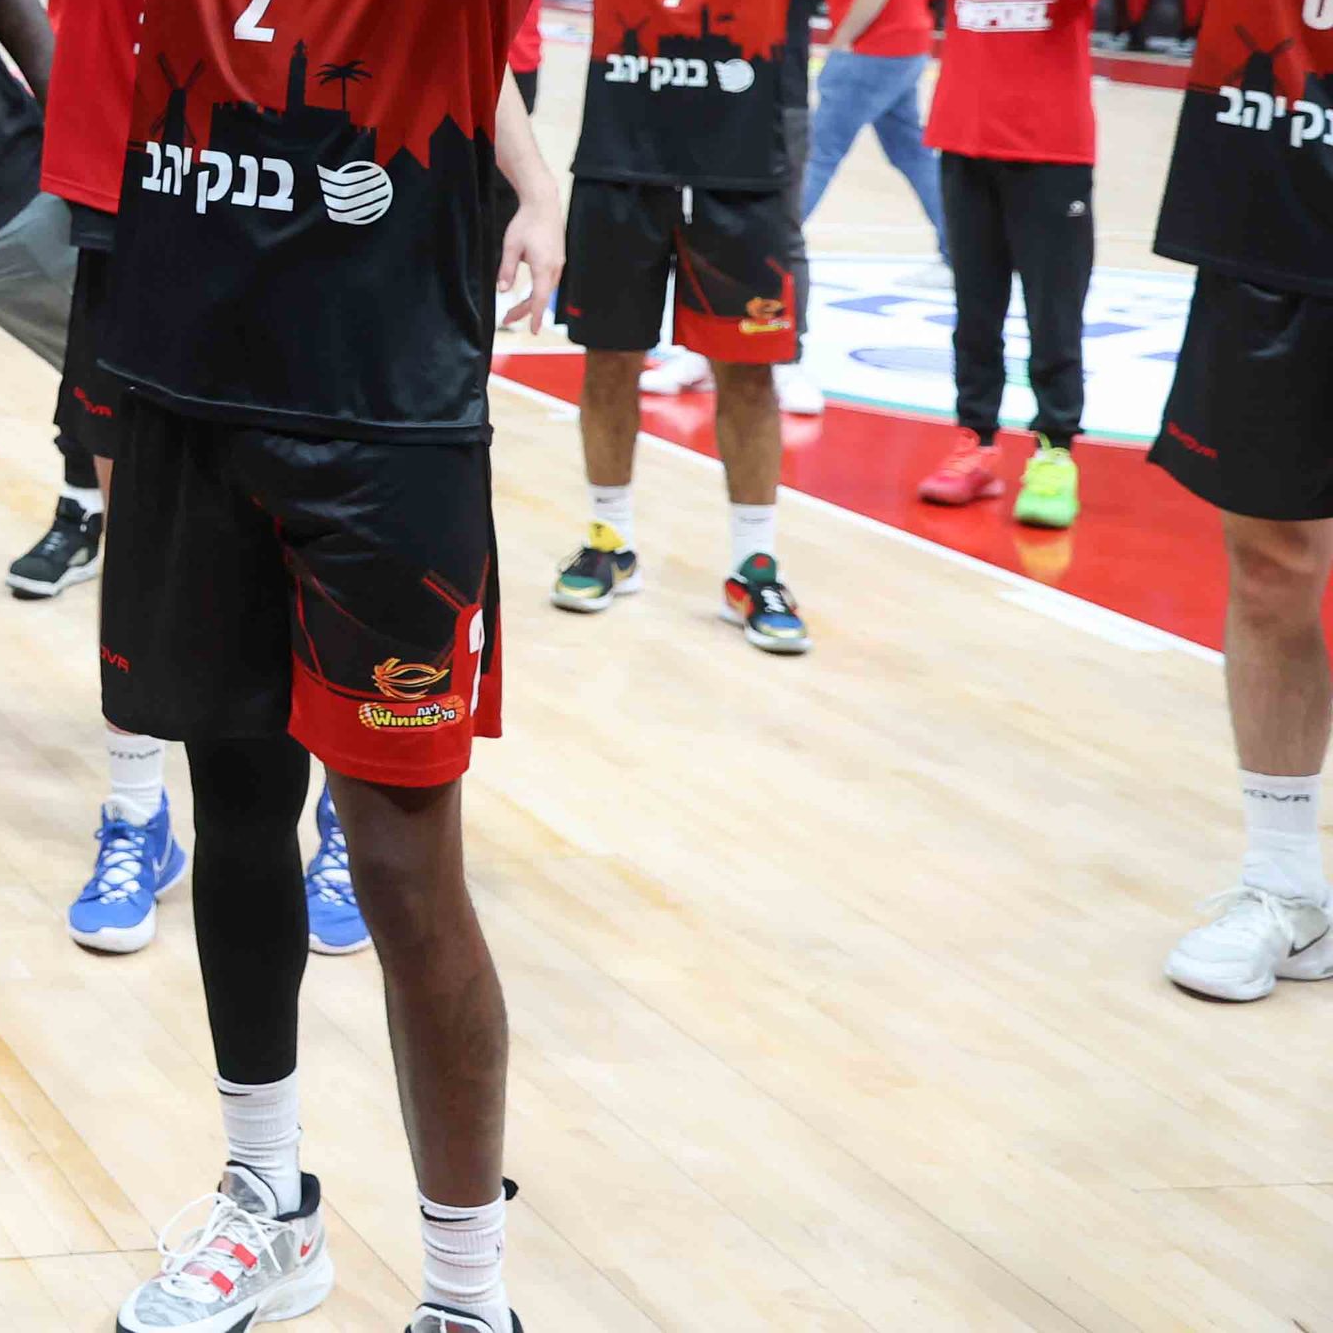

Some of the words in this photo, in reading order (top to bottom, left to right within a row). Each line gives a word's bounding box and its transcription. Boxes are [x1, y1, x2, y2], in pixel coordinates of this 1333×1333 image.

[650, 57, 709, 92] בנק
[1215, 85, 1287, 131] יהב
[141, 140, 193, 197] יהב
[195, 148, 295, 214] בנק
[373, 707, 442, 727] Winner
[441, 708, 455, 721] סל
[417, 703, 440, 717] ליגת
